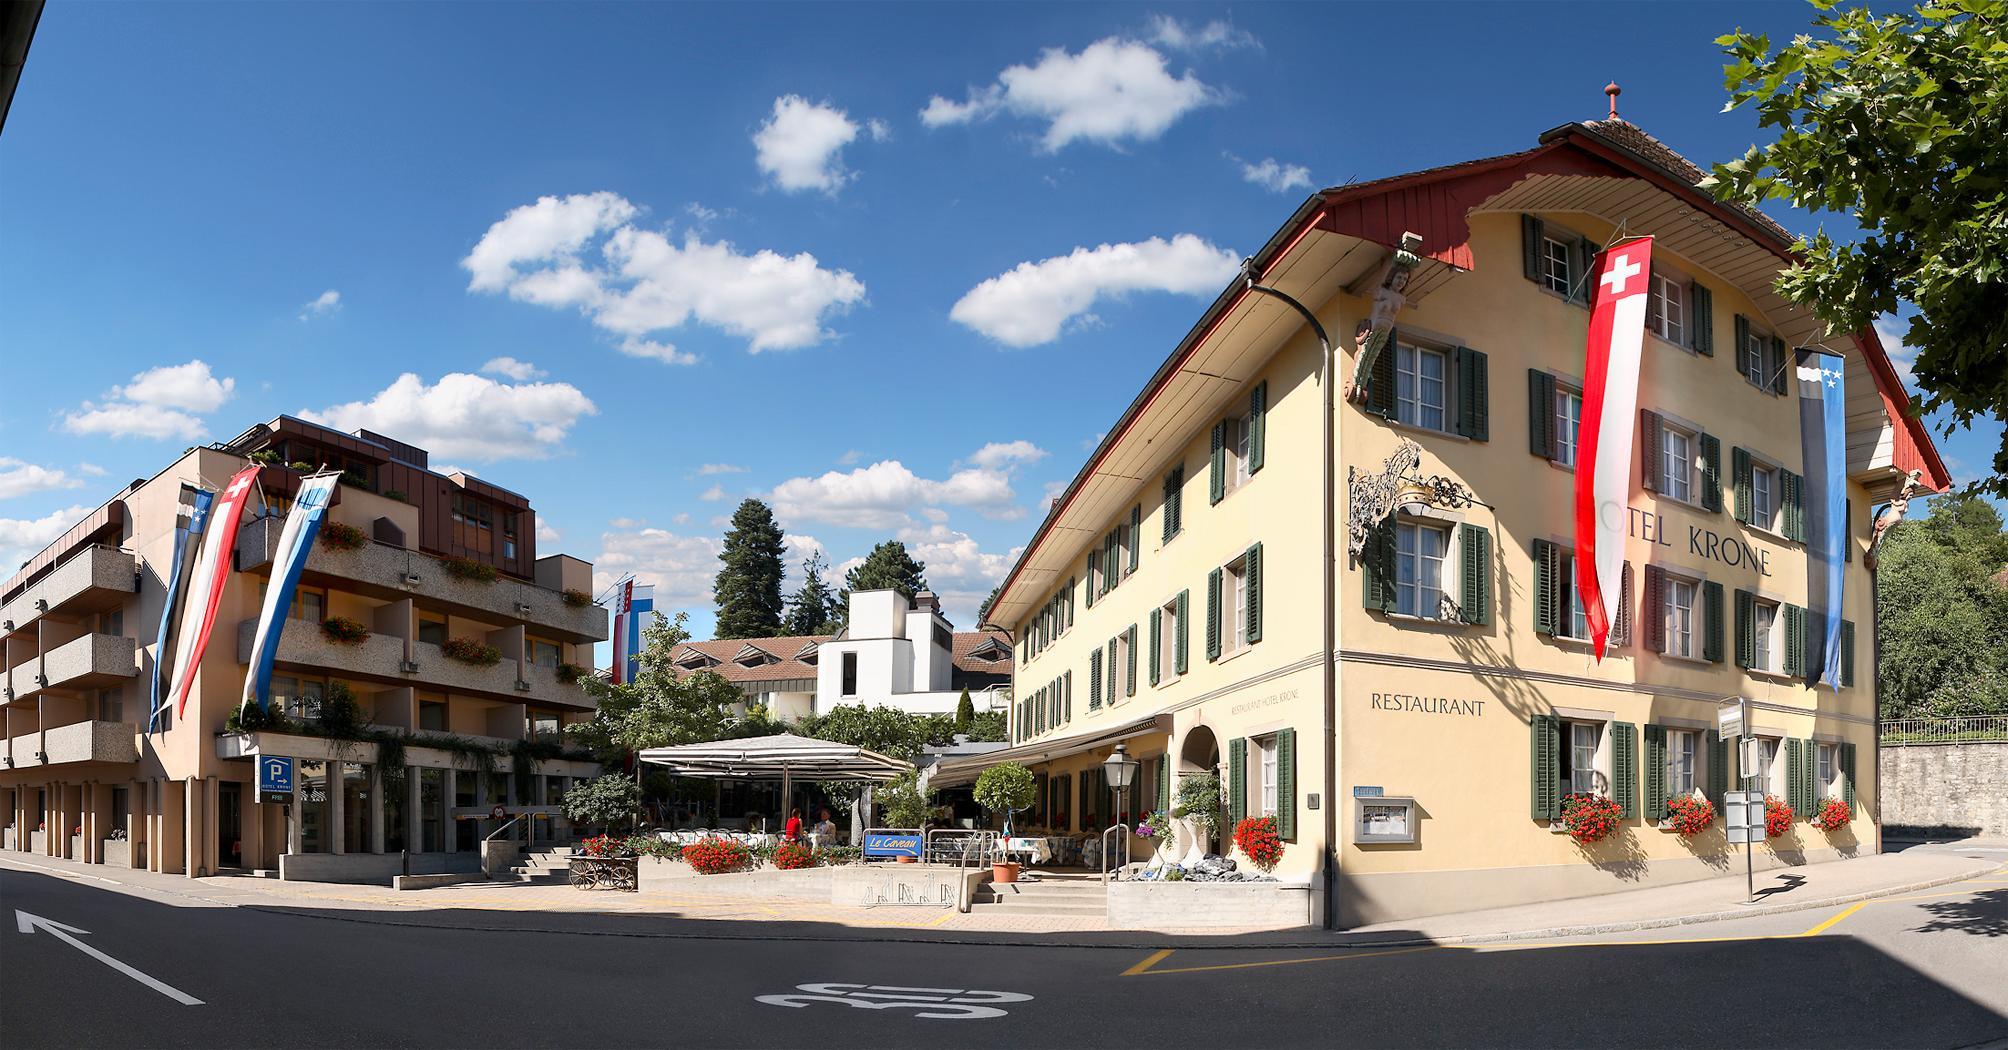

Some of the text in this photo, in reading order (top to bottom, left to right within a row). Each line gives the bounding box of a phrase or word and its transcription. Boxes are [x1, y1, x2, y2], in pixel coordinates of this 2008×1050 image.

[1600, 501, 1772, 577] OTEL KRONE
[1371, 693, 1485, 716] RESTAURANT
[271, 764, 282, 781] P
[869, 837, 917, 848] Le Caveau
